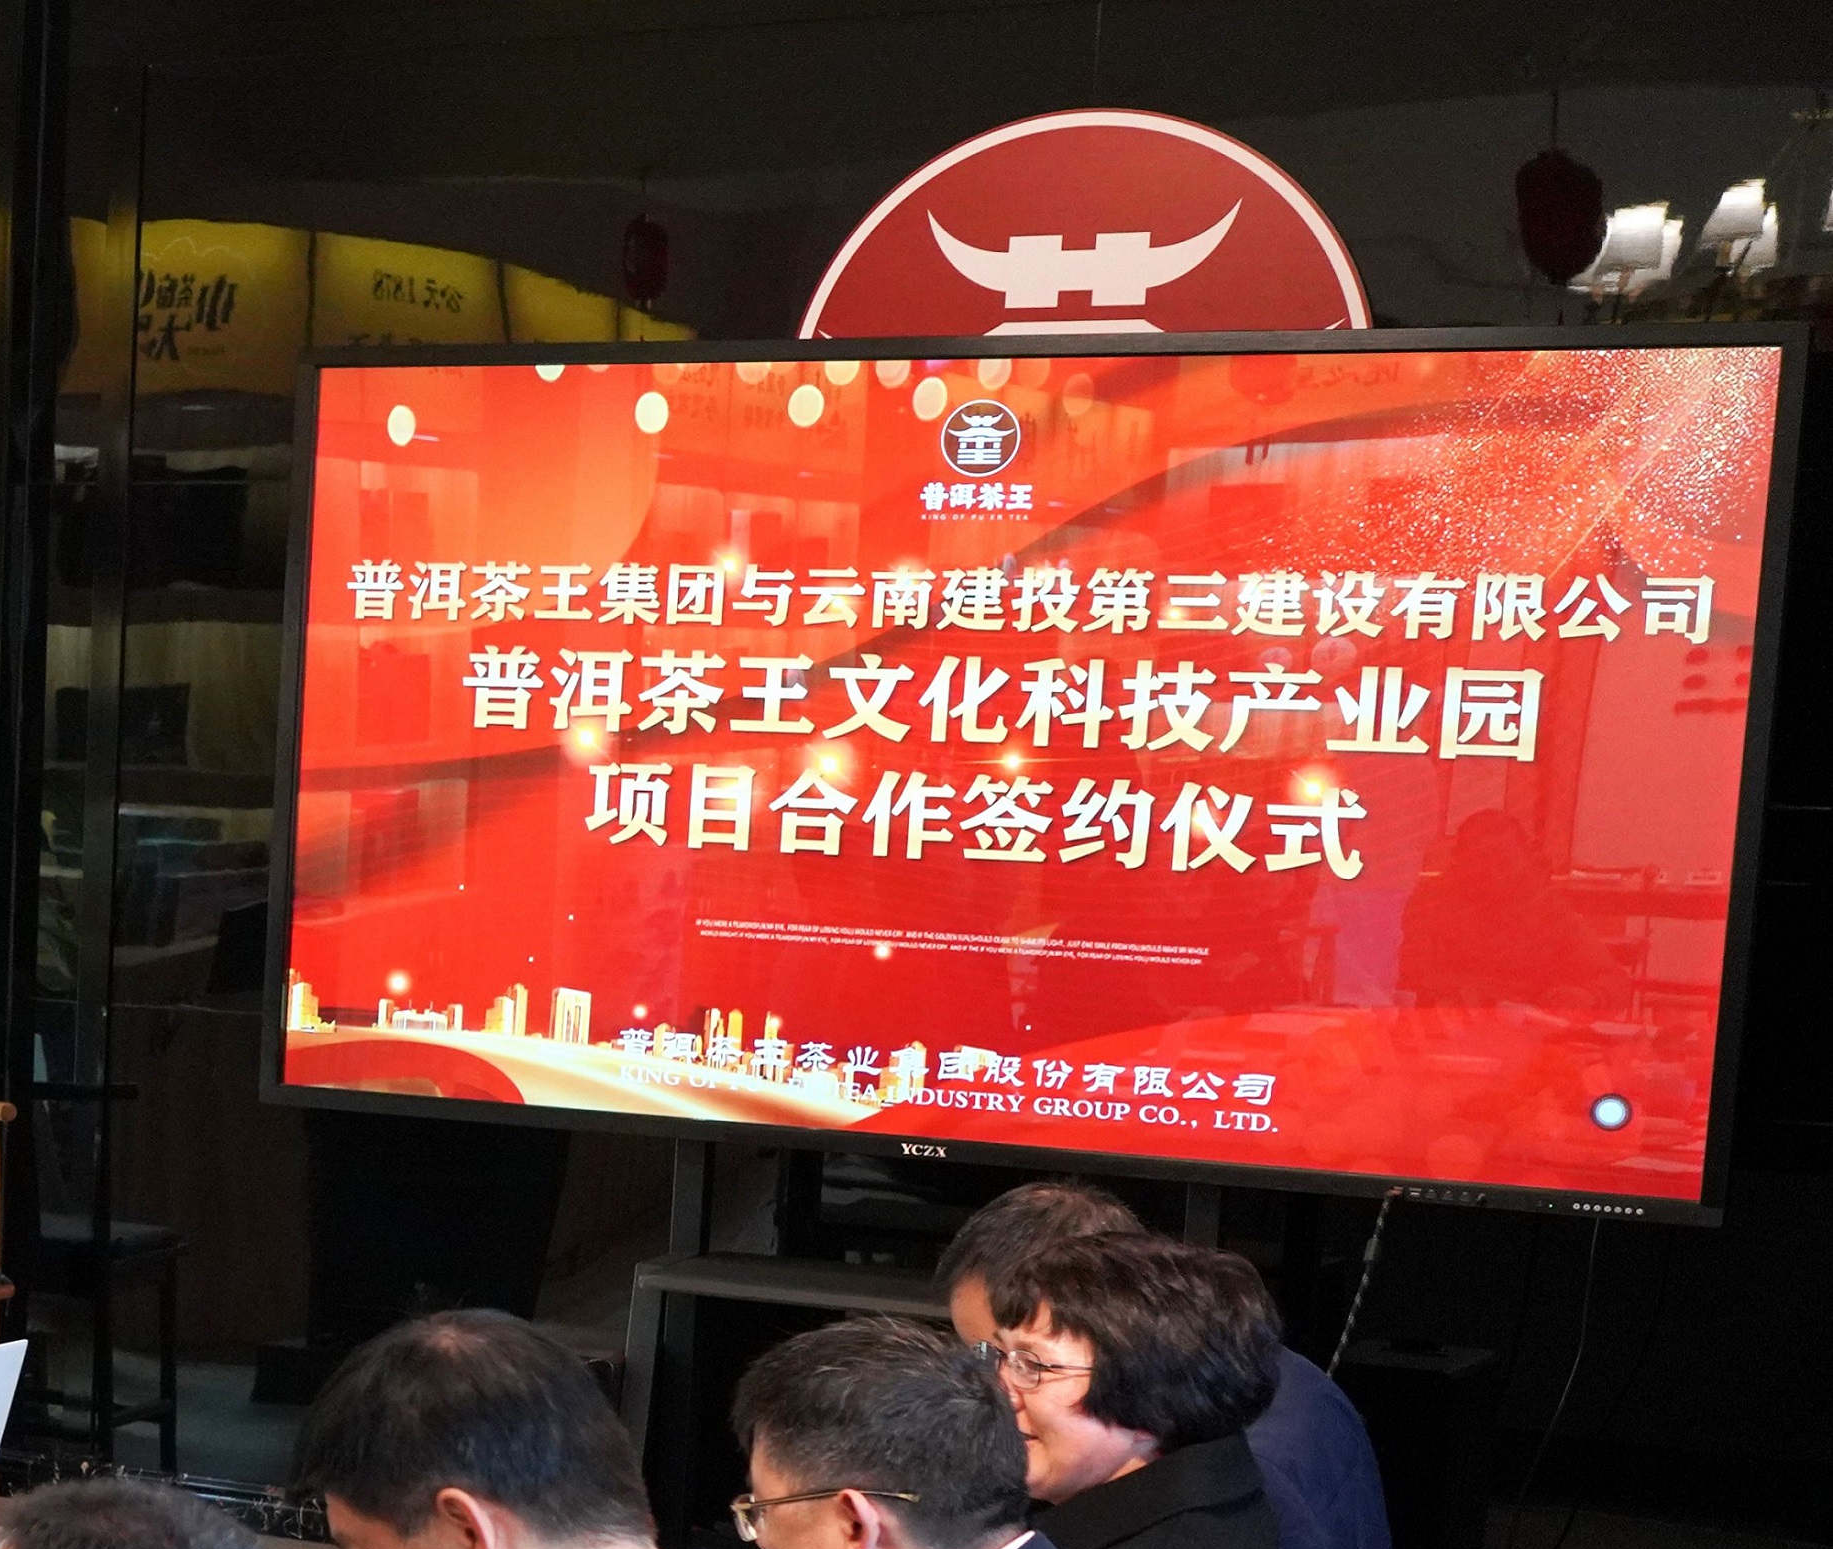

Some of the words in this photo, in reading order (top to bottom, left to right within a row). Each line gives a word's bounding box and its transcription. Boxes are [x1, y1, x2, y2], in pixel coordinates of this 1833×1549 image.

[920, 482, 1033, 511] 普洱茶王
[1009, 513, 1029, 521] TEA
[346, 558, 1715, 646] 普洱茶王集团与云南建投第三建设有限公司
[463, 645, 1543, 763] 普洱茶王文化科技产业园
[585, 761, 1368, 881] 项目合作签约仪式
[617, 1027, 1277, 1106] 普洱茶王茶业集团股份有限公司
[619, 1063, 682, 1089] KING
[883, 1083, 1025, 1113] INDUSTRY
[1032, 1093, 1132, 1123] GROUP
[1213, 1110, 1279, 1135] LTD.
